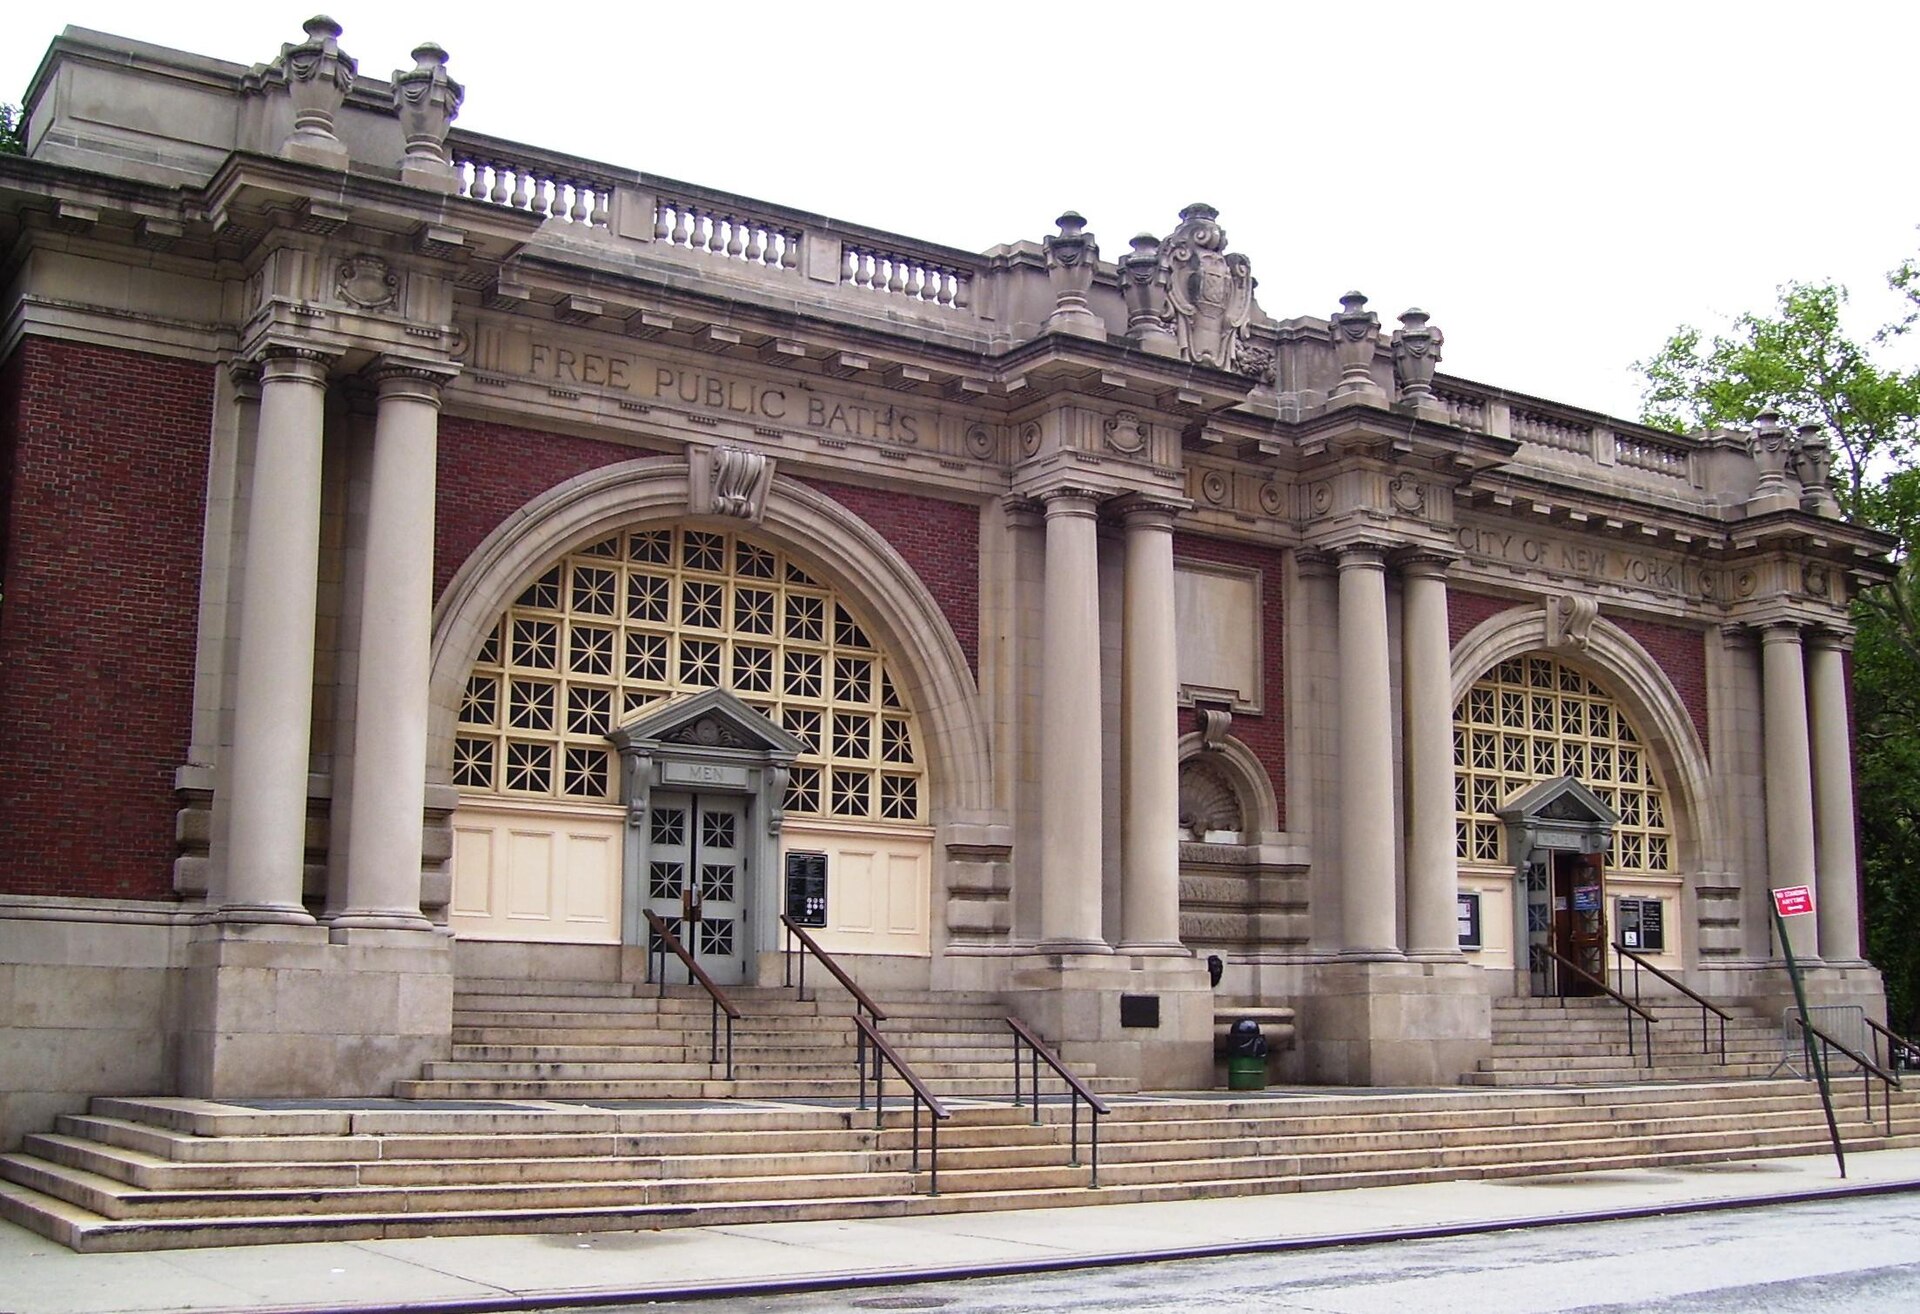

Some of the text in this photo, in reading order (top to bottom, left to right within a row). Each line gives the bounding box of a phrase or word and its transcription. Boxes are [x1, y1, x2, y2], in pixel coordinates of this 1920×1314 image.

[529, 343, 919, 445] FREE PUBLIC BATHS
[1457, 526, 1675, 588] CITY OF NEW YORK
[689, 766, 724, 781] MEN
